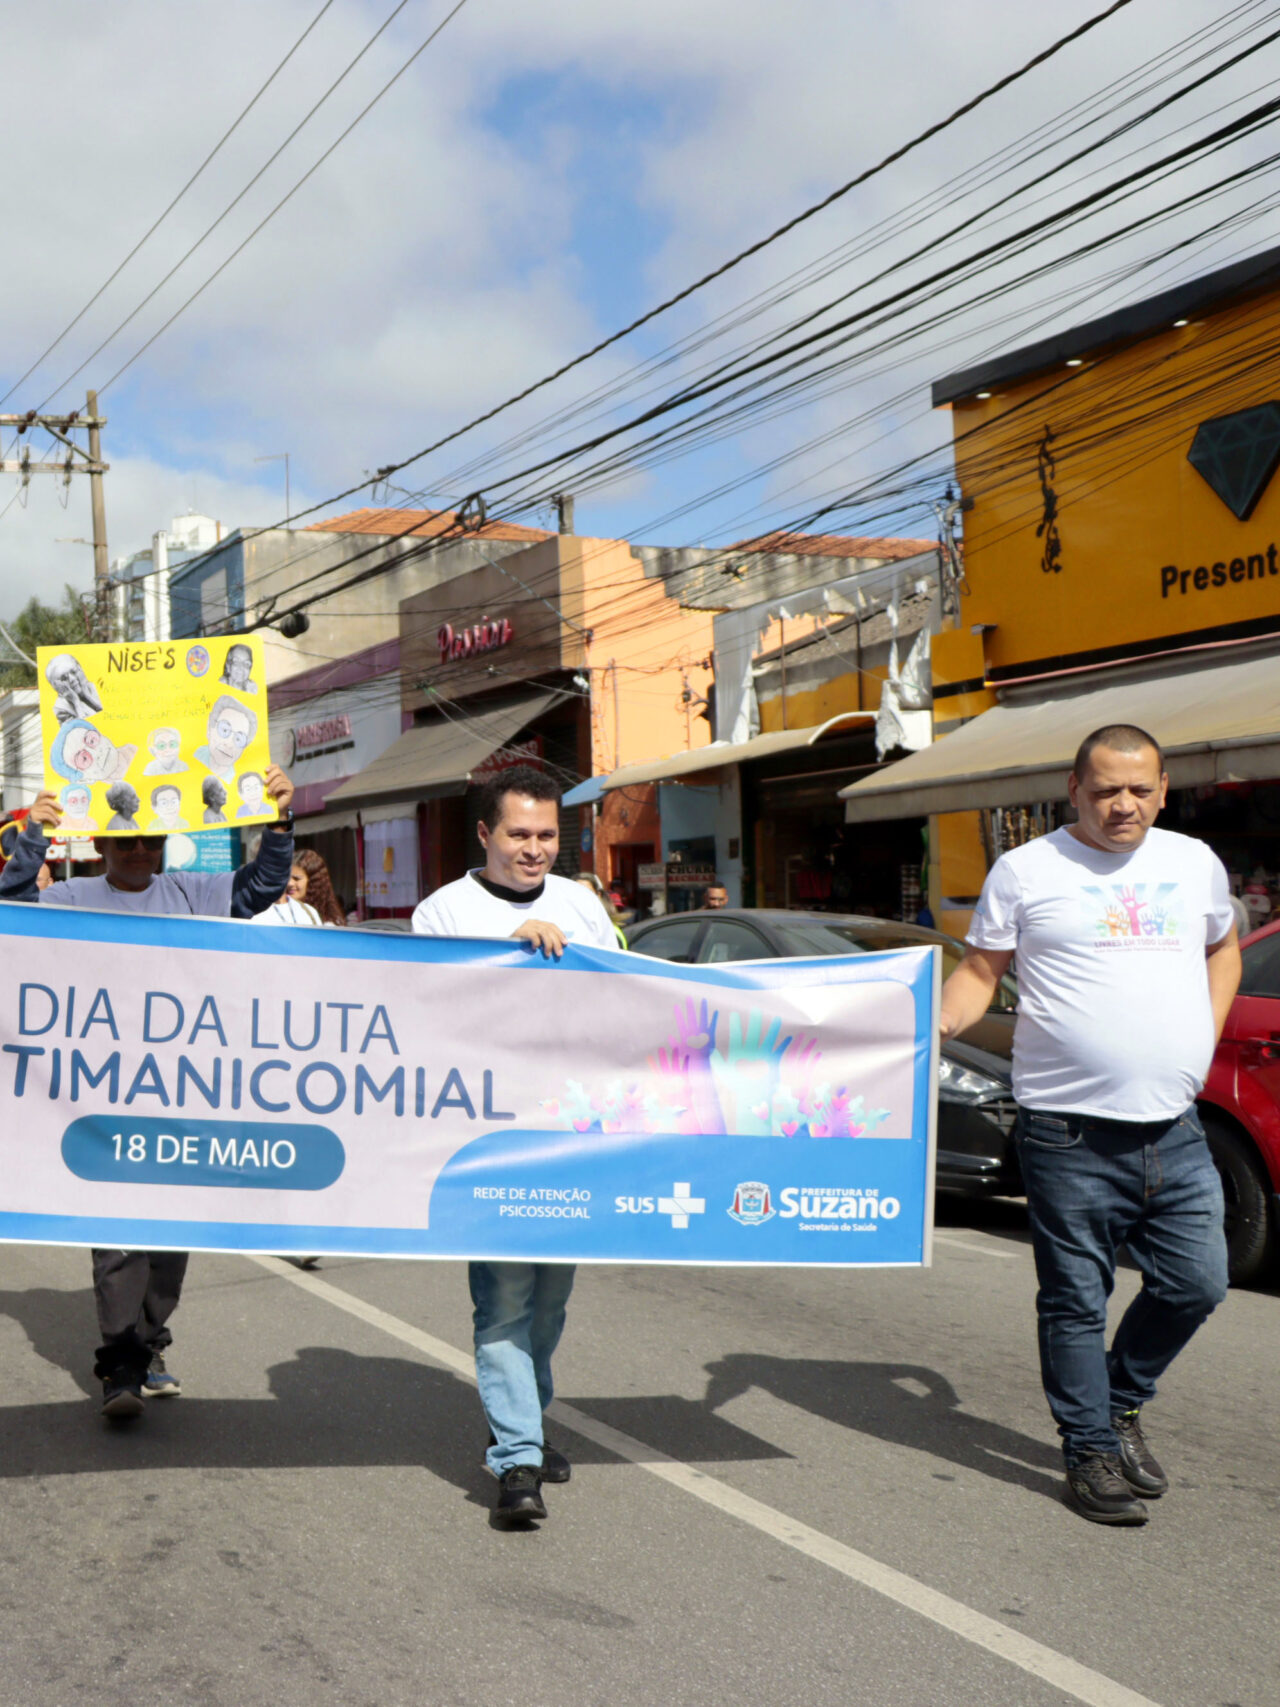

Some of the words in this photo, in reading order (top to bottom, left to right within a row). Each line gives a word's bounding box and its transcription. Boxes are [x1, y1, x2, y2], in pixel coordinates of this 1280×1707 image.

[18, 982, 121, 1041] DIA
[141, 991, 228, 1048] DA
[251, 998, 401, 1056] LUTA
[111, 1132, 147, 1162] 18
[156, 1134, 199, 1166] DE
[208, 1136, 297, 1169] MAIO
[473, 1186, 506, 1200] REDE
[509, 1187, 526, 1200] DE
[529, 1187, 591, 1203] ATENÇÃO
[801, 1187, 863, 1197] PREFEITURA
[865, 1189, 879, 1197] DE
[499, 1204, 591, 1219] PSICOSSOCIAL
[614, 1196, 655, 1214] SUS
[779, 1187, 900, 1220] Suzano
[799, 1222, 839, 1232] Secretaria
[840, 1223, 851, 1232] de
